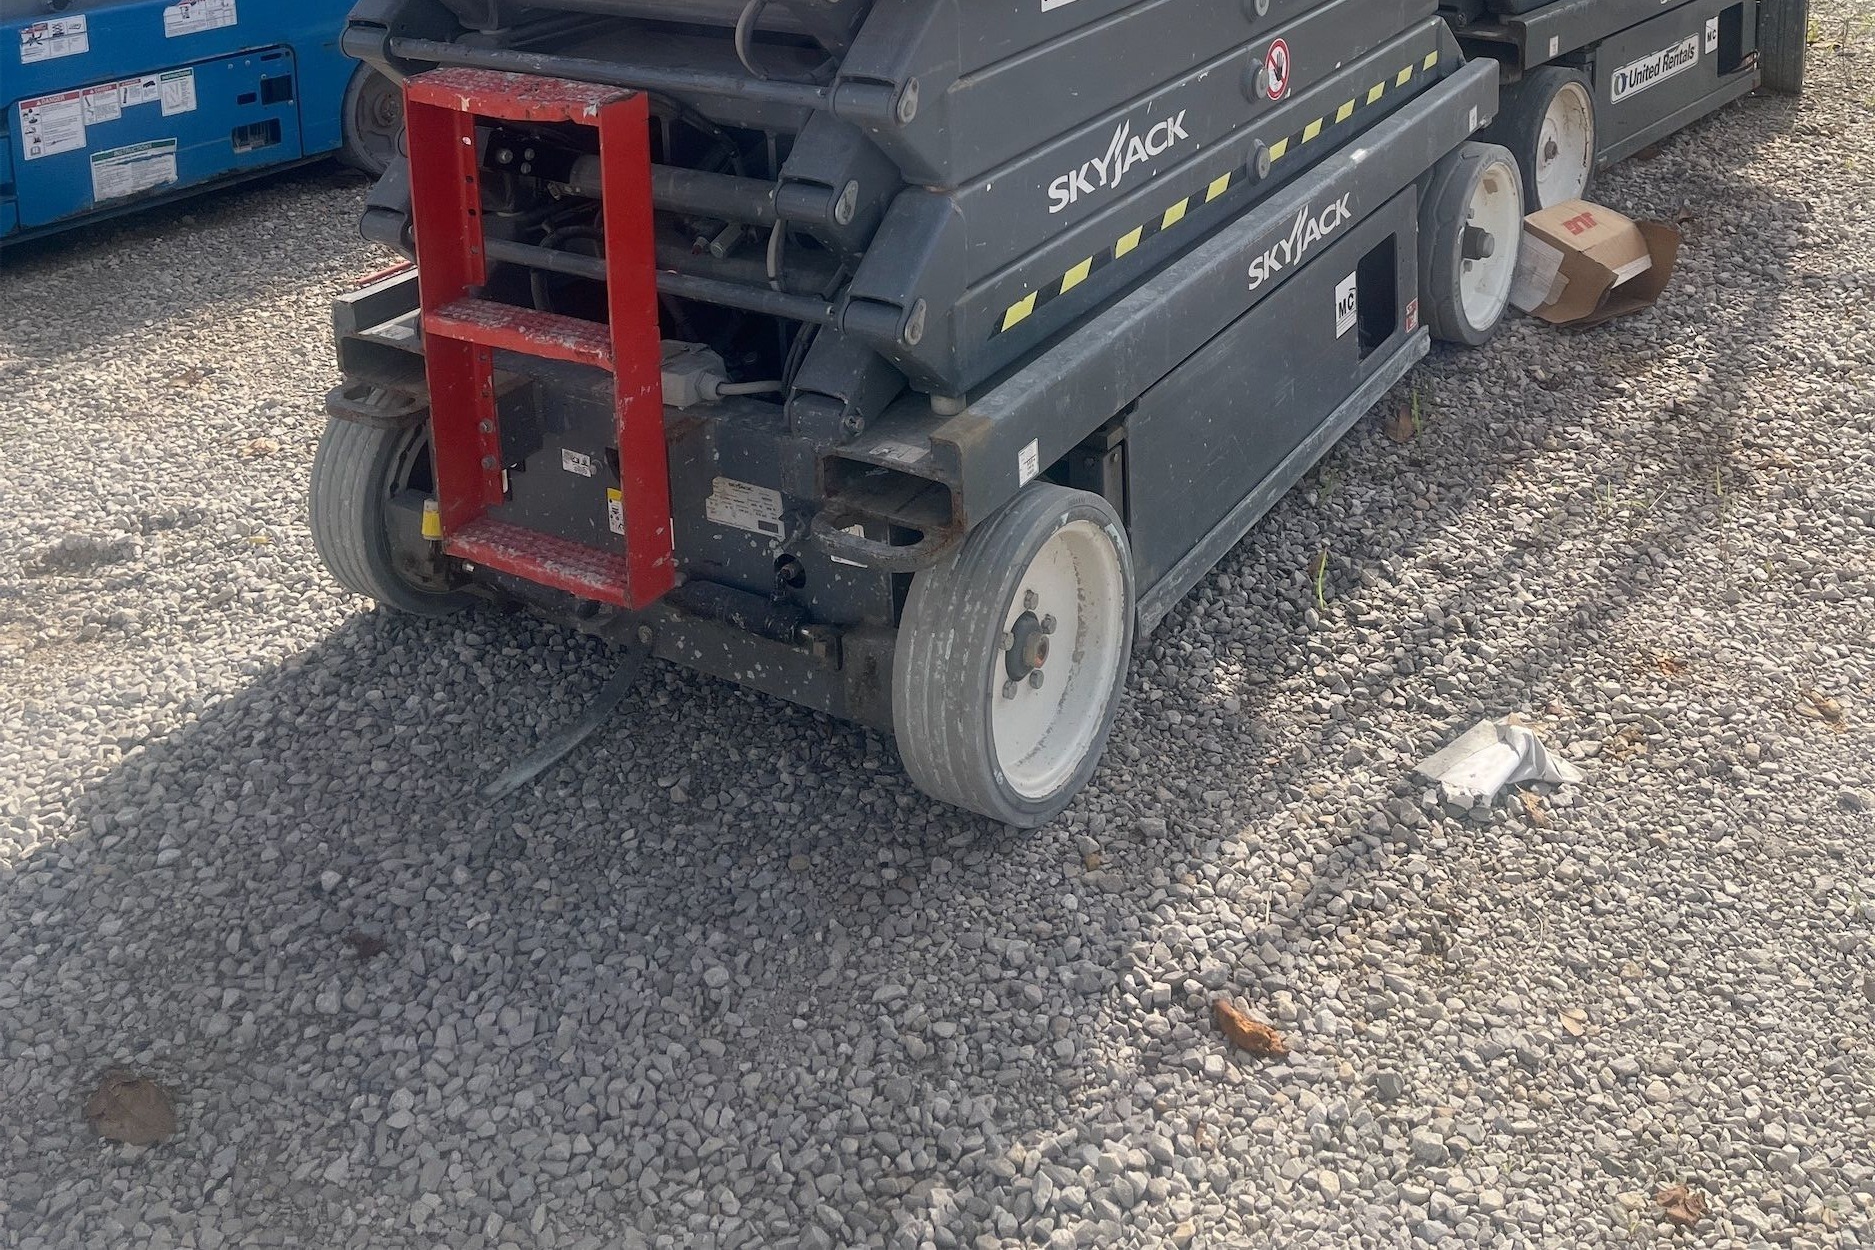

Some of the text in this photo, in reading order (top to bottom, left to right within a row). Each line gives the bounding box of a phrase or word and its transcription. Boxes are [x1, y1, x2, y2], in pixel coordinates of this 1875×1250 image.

[1706, 29, 1717, 43] MC
[1628, 42, 1695, 88] United Rentals
[1048, 109, 1190, 214] SKYJACK
[1248, 192, 1352, 291] SKYJACK
[1338, 292, 1355, 319] MC
